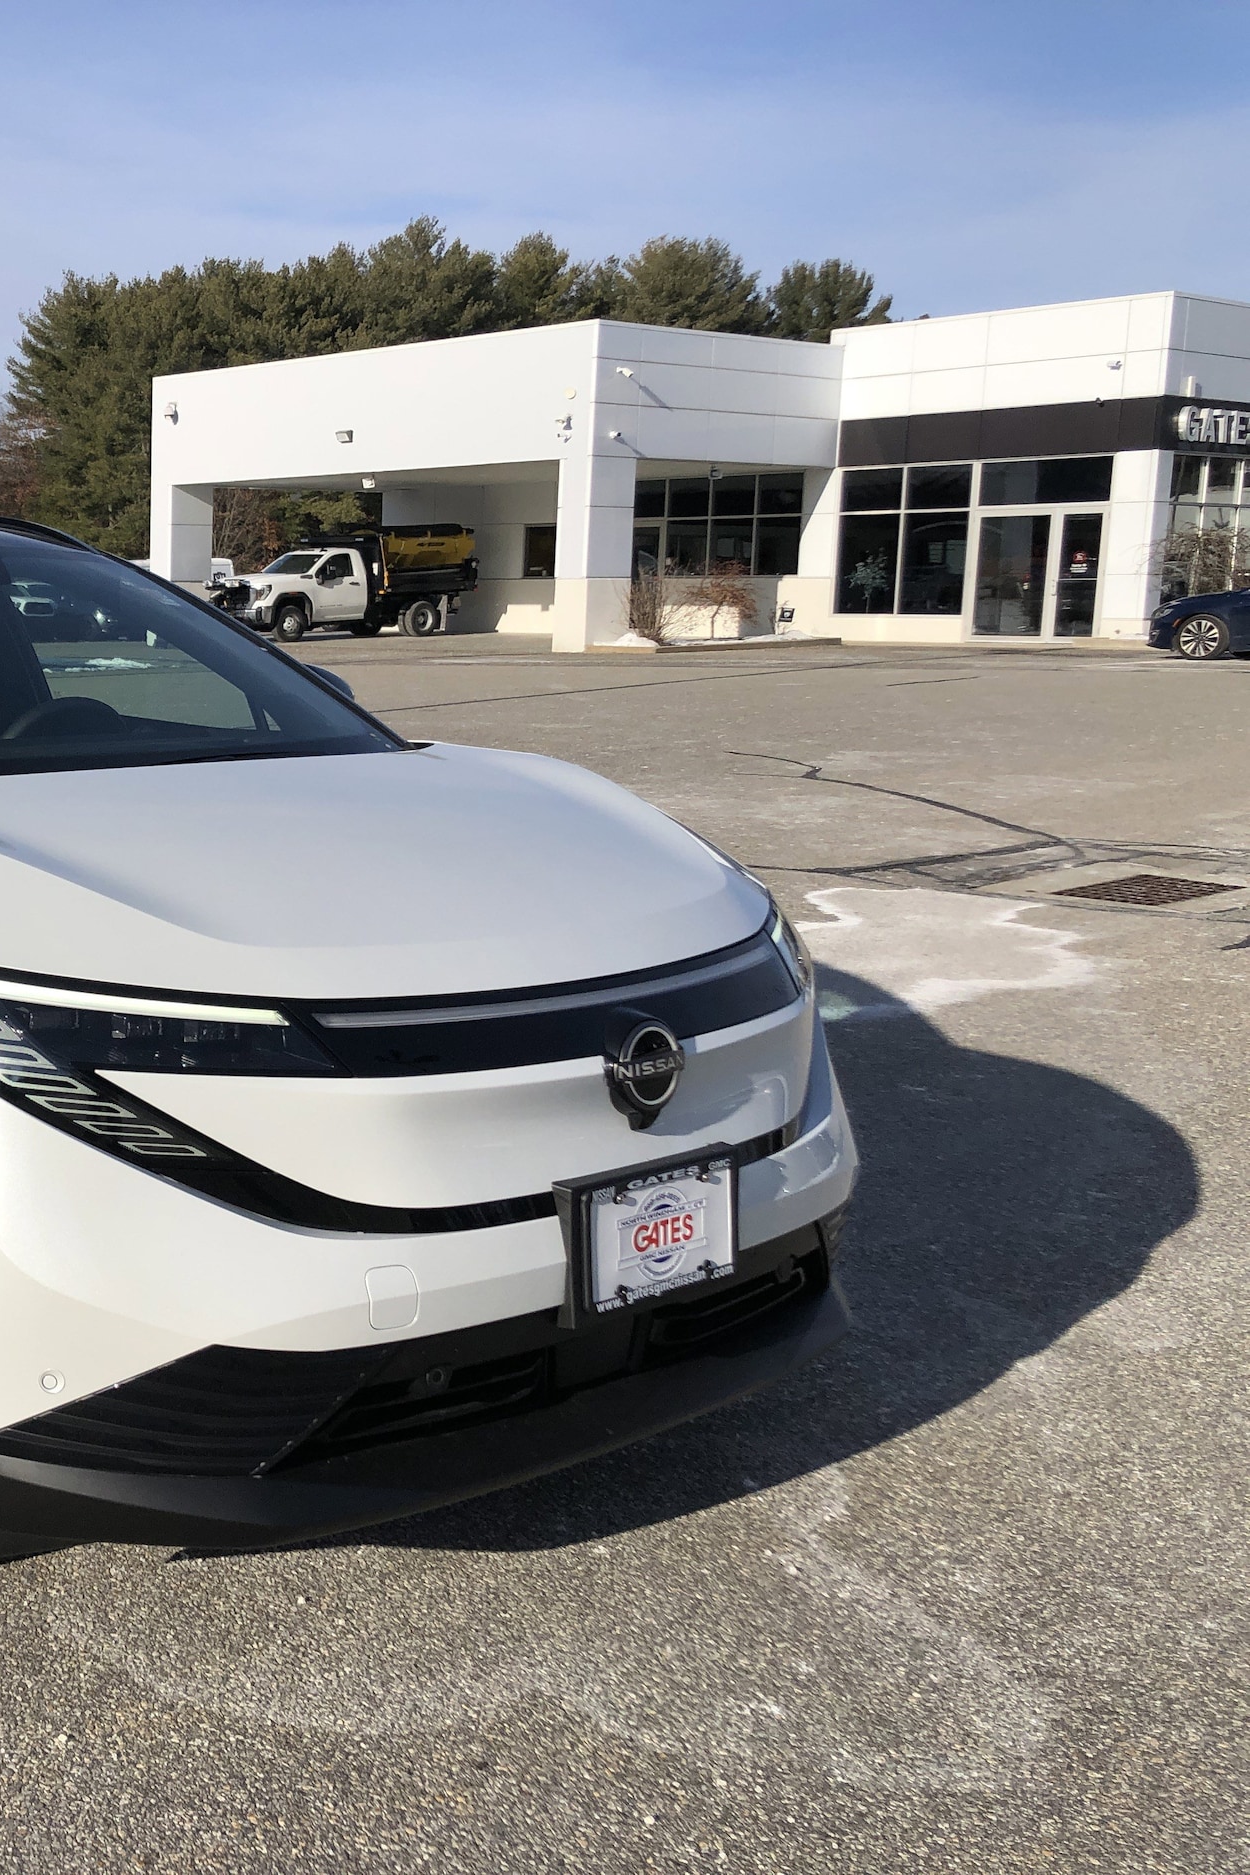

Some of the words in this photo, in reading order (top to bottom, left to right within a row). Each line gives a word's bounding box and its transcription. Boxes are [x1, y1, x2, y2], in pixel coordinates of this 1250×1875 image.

[1177, 405, 1250, 445] GATE
[616, 1054, 683, 1079] NISSAN
[707, 1158, 730, 1171] GMC
[627, 1165, 700, 1190] GATES
[633, 1214, 694, 1253] GATES
